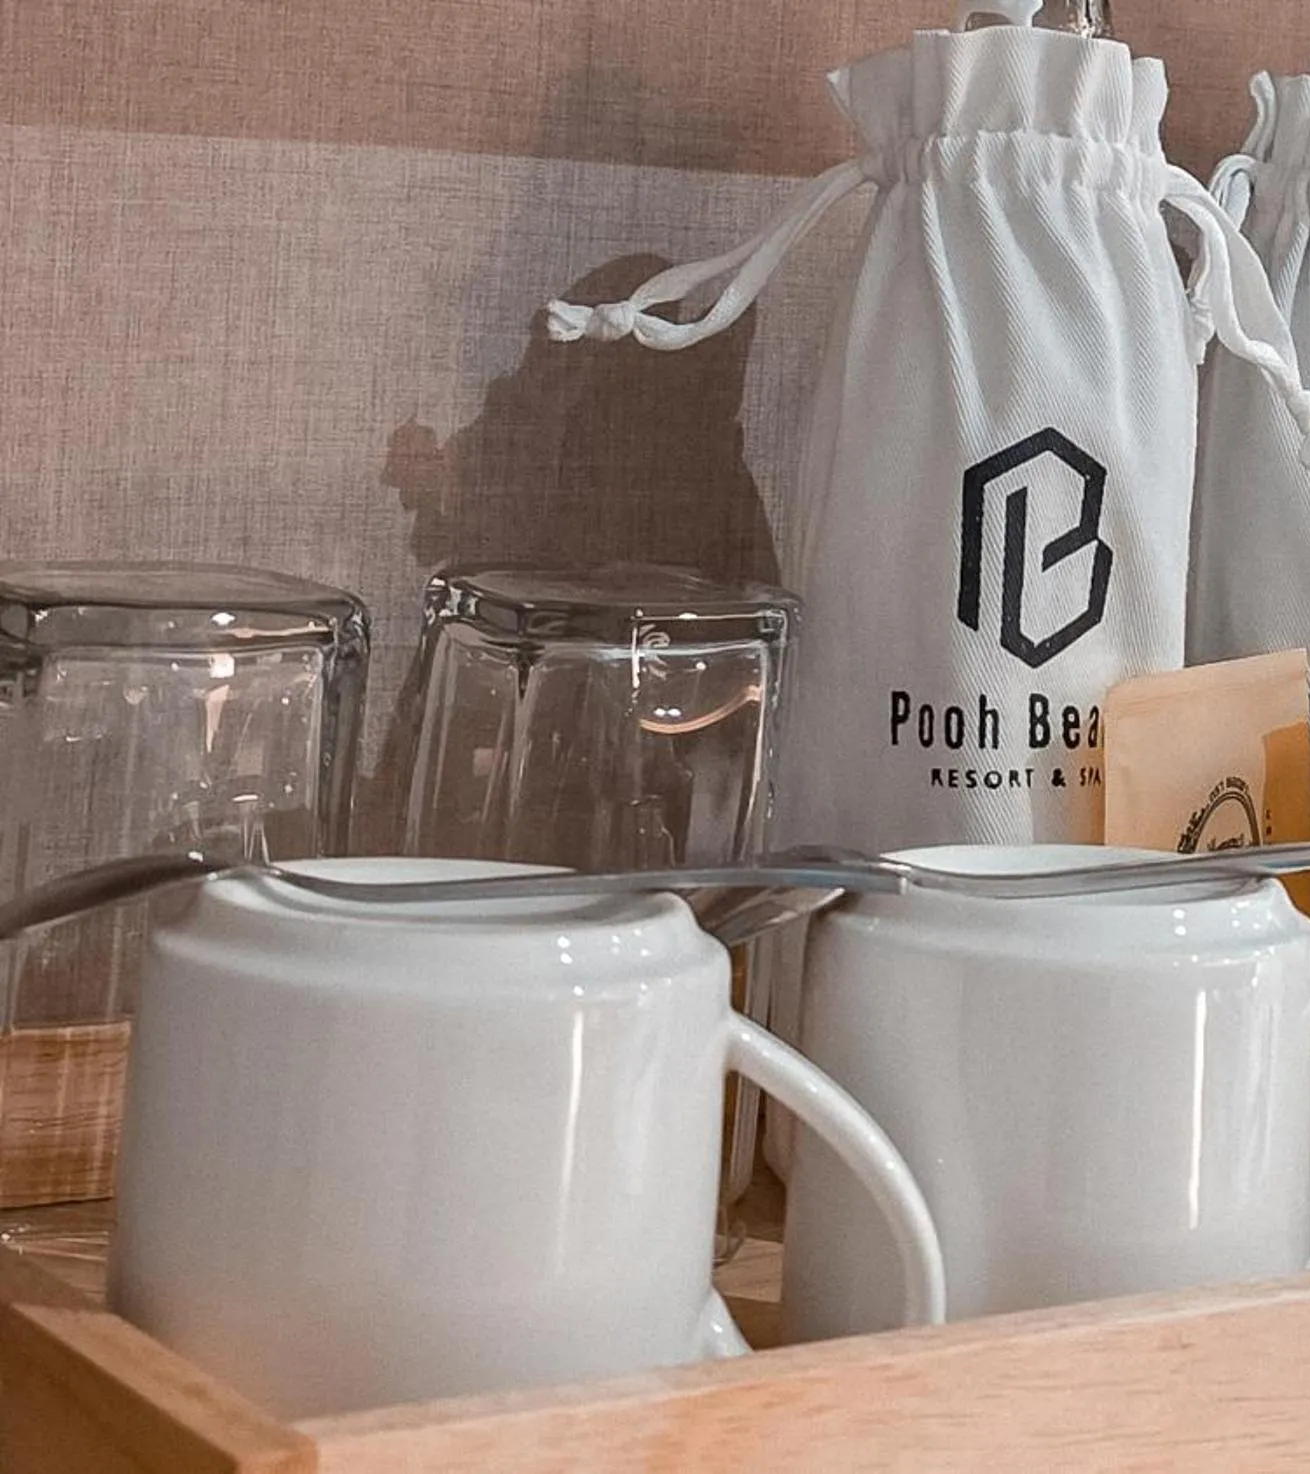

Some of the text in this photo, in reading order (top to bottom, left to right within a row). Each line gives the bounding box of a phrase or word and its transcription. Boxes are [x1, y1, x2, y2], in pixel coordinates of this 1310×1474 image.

[890, 690, 1104, 750] Pooh Bea
[930, 767, 1035, 790] RESORT
[1051, 768, 1068, 788] &
